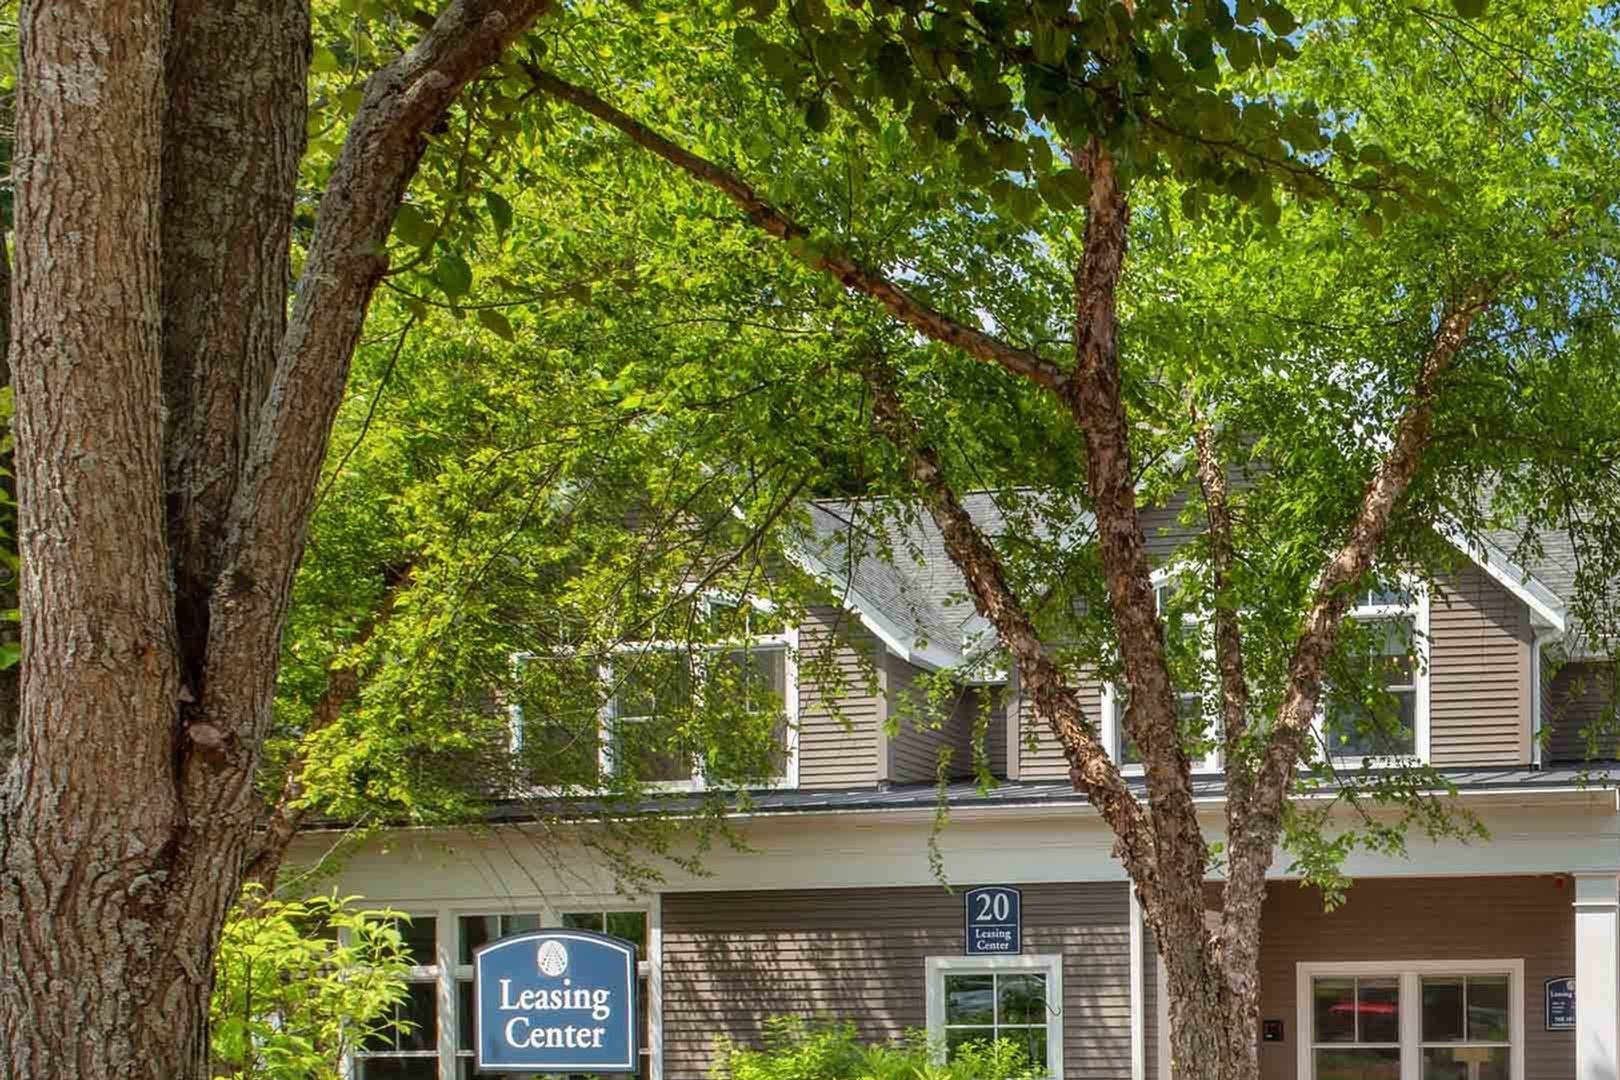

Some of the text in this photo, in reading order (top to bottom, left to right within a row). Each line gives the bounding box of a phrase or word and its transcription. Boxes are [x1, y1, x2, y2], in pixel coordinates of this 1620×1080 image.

[975, 892, 1009, 921] 20
[975, 928, 1011, 940] Leasing
[976, 940, 1009, 950] Center
[498, 978, 611, 1021] Leasing
[505, 1016, 606, 1049] Center
